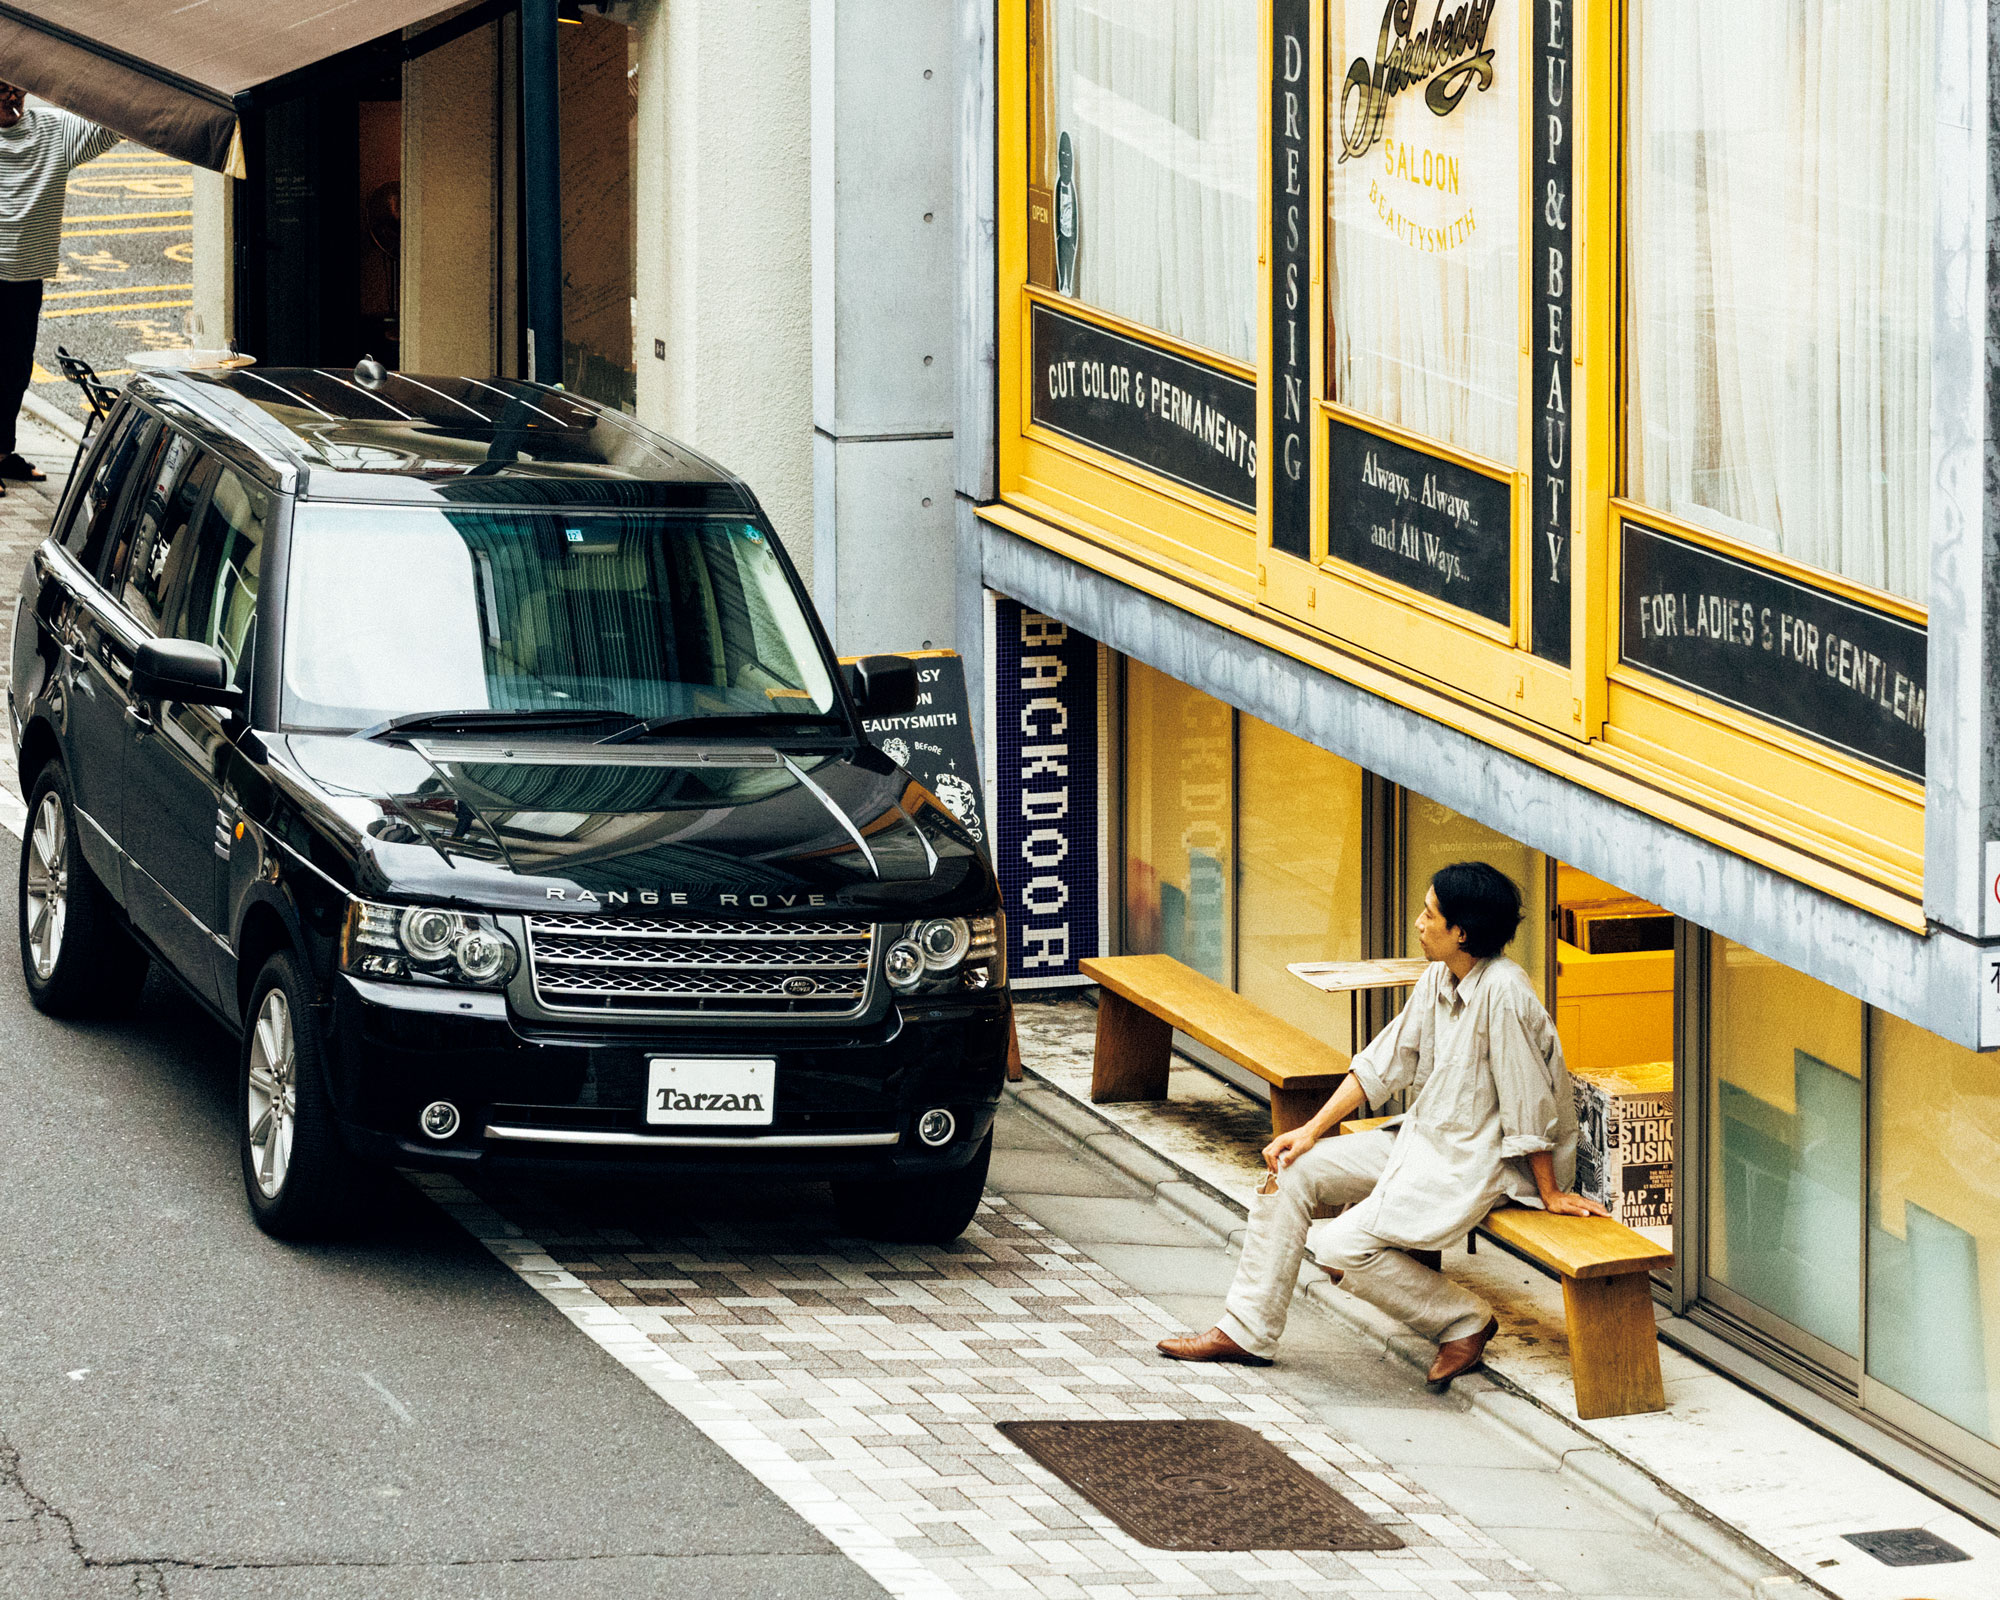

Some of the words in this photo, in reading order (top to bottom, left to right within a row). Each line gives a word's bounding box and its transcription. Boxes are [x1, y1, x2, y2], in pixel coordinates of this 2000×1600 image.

[1337, 0, 1496, 164] Speakeasy
[1384, 138, 1459, 196] SALOON
[1031, 204, 1049, 224] OPEN
[1369, 178, 1476, 253] BEAUTYSMITH
[1544, 178, 1567, 231] &
[1283, 34, 1302, 481] DRESSING
[1048, 361, 1076, 400] CUT
[1082, 361, 1131, 405] COLOR
[1135, 371, 1146, 409] &
[1151, 376, 1257, 479] PERMANENTS
[1546, 247, 1567, 585] BEAUTY
[1370, 518, 1396, 553] and
[1399, 522, 1420, 562] All
[1639, 593, 1678, 639] FOR
[1682, 593, 1755, 648] LADIES
[1781, 613, 1819, 671] FOR
[1825, 633, 1926, 732] GENTLEM
[861, 713, 958, 734] EAUTYSMITH
[1020, 609, 1069, 968] BACKDOOR
[545, 887, 688, 905] RANGE
[719, 893, 857, 907] ROVER
[656, 1088, 765, 1112] Tarzan
[1620, 1119, 1673, 1144] STRIC
[1620, 1141, 1673, 1164] BUSIN
[1622, 1204, 1657, 1218] UNKY
[1622, 1215, 1669, 1229] ATURDAY
